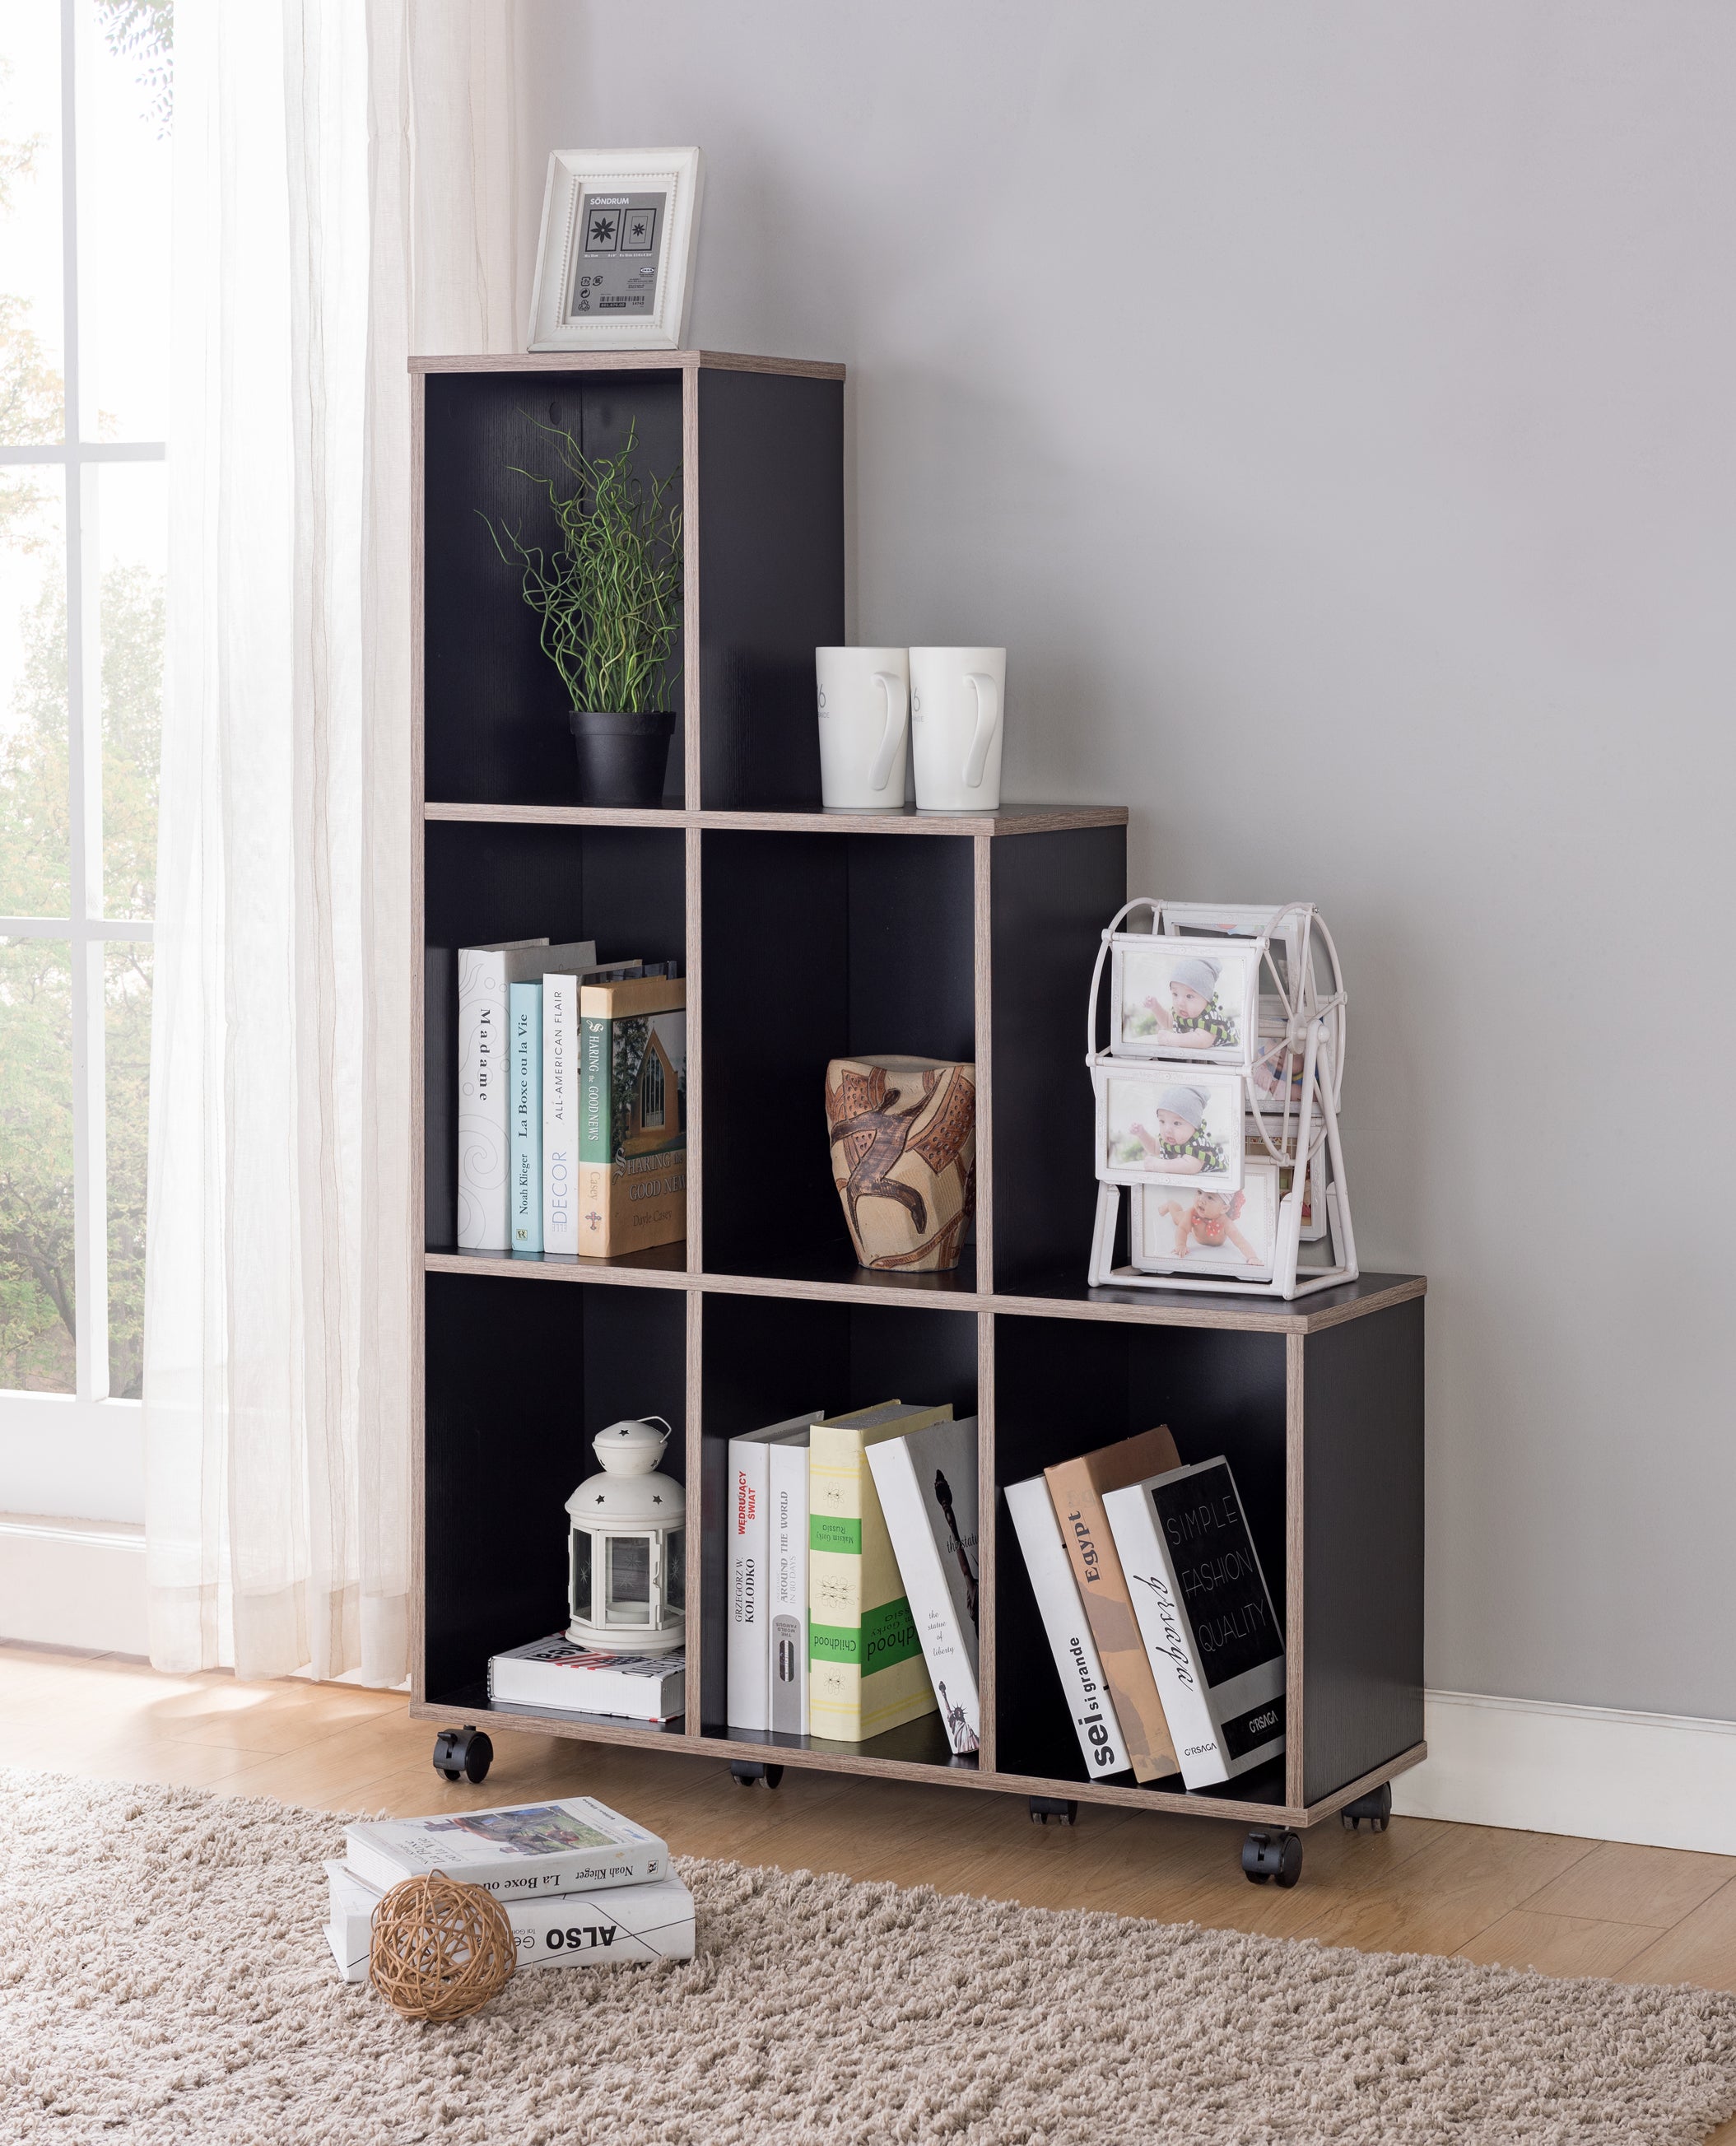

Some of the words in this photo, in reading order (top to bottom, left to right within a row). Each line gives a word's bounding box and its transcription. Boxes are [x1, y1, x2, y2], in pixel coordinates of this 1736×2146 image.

[589, 197, 630, 205] SÖNDRUM
[554, 991, 562, 1023] FLAIR
[518, 1013, 528, 1038] Vie
[479, 1008, 491, 1101] Madame
[518, 1041, 528, 1054] la
[586, 1019, 604, 1072] SHARING
[519, 1059, 528, 1076] ou
[554, 1029, 563, 1120] ALL-AMERICAN
[518, 1080, 528, 1115] Boxe
[588, 1086, 599, 1113] GOOD
[518, 1120, 528, 1138] La
[588, 1114, 599, 1142] NEWS
[519, 1153, 531, 1186] Klieger
[612, 1147, 671, 1185] SHARING
[552, 1152, 568, 1224] DECOR
[589, 1171, 601, 1201] Casey
[630, 1180, 662, 1201] GOOD
[663, 1175, 686, 1194] NEW
[519, 1189, 528, 1215] Noah
[633, 1211, 652, 1227] Dayle
[653, 1210, 673, 1223] Casey
[822, 1525, 845, 1534] Russia
[1166, 1495, 1238, 1545] SIMPLE
[816, 1531, 831, 1542] Gorky
[961, 1533, 979, 1548] statu
[1068, 1510, 1101, 1584] Egypt
[1181, 1547, 1254, 1599] FASHION
[735, 1571, 743, 1622] GRZEGORZ
[745, 1559, 756, 1623] KOLODKO
[789, 1581, 796, 1592] 80
[789, 1594, 797, 1604] IN
[885, 1607, 911, 1622] ssia
[927, 1621, 947, 1631] statue
[929, 1609, 939, 1619] the
[1198, 1599, 1267, 1652] QUALITY
[872, 1621, 900, 1637] Gorky
[936, 1631, 943, 1643] of
[814, 1636, 857, 1651] Childhood
[867, 1626, 918, 1662] dhood
[933, 1646, 955, 1657] liberty
[1069, 1636, 1096, 1692] grande
[1084, 1696, 1100, 1711] si
[1077, 1713, 1115, 1767] sei
[505, 1877, 538, 1889] Boxe
[543, 1874, 561, 1886] La
[575, 1867, 607, 1880] Klieger
[608, 1865, 634, 1877] Noah
[483, 1881, 500, 1891] ou
[546, 1925, 617, 1950] ALSO
